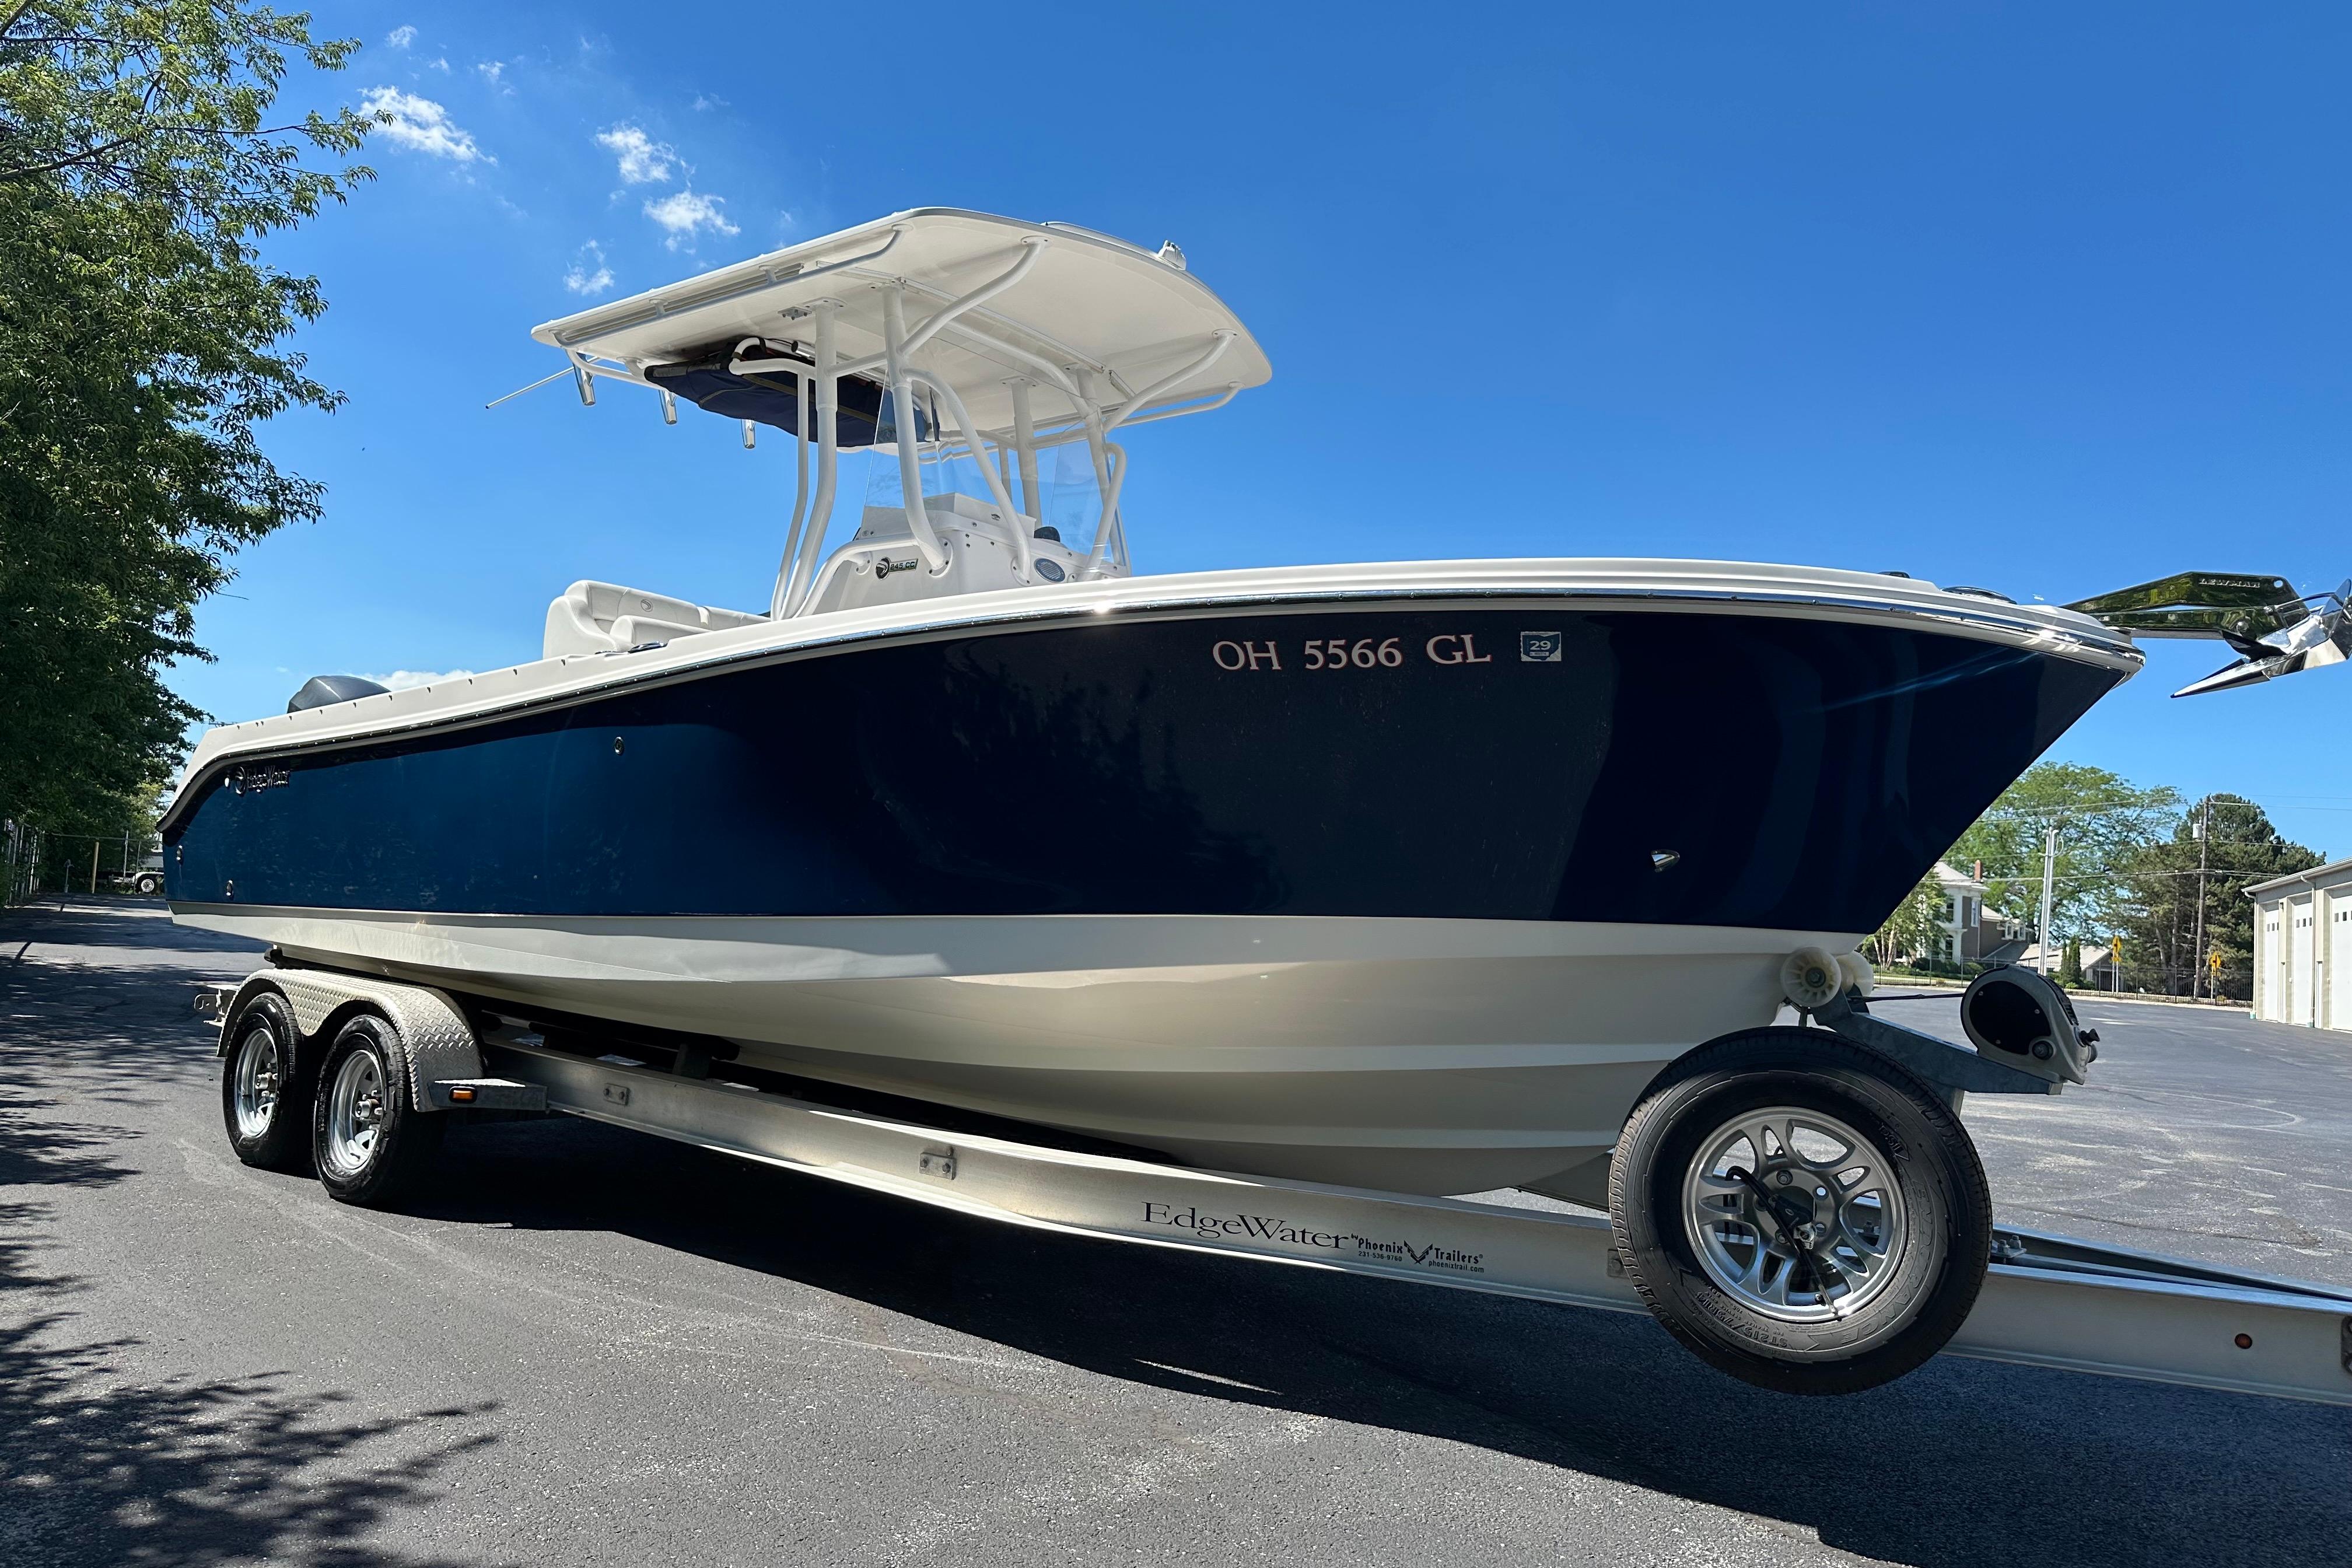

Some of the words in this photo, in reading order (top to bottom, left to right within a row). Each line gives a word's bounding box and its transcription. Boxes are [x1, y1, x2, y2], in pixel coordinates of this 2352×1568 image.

[1212, 640, 1282, 671] OH
[1304, 637, 1404, 670] 5566
[1426, 634, 1492, 665] GL
[1529, 640, 1551, 650] 29
[1140, 1201, 1349, 1250] EdgeWater
[1358, 1237, 1403, 1254] Phoenix
[1358, 1250, 1402, 1262] 231-536-9760
[1429, 1259, 1485, 1273] phoenixtrail.com
[1841, 1180, 1933, 1344] ENDURANCE
